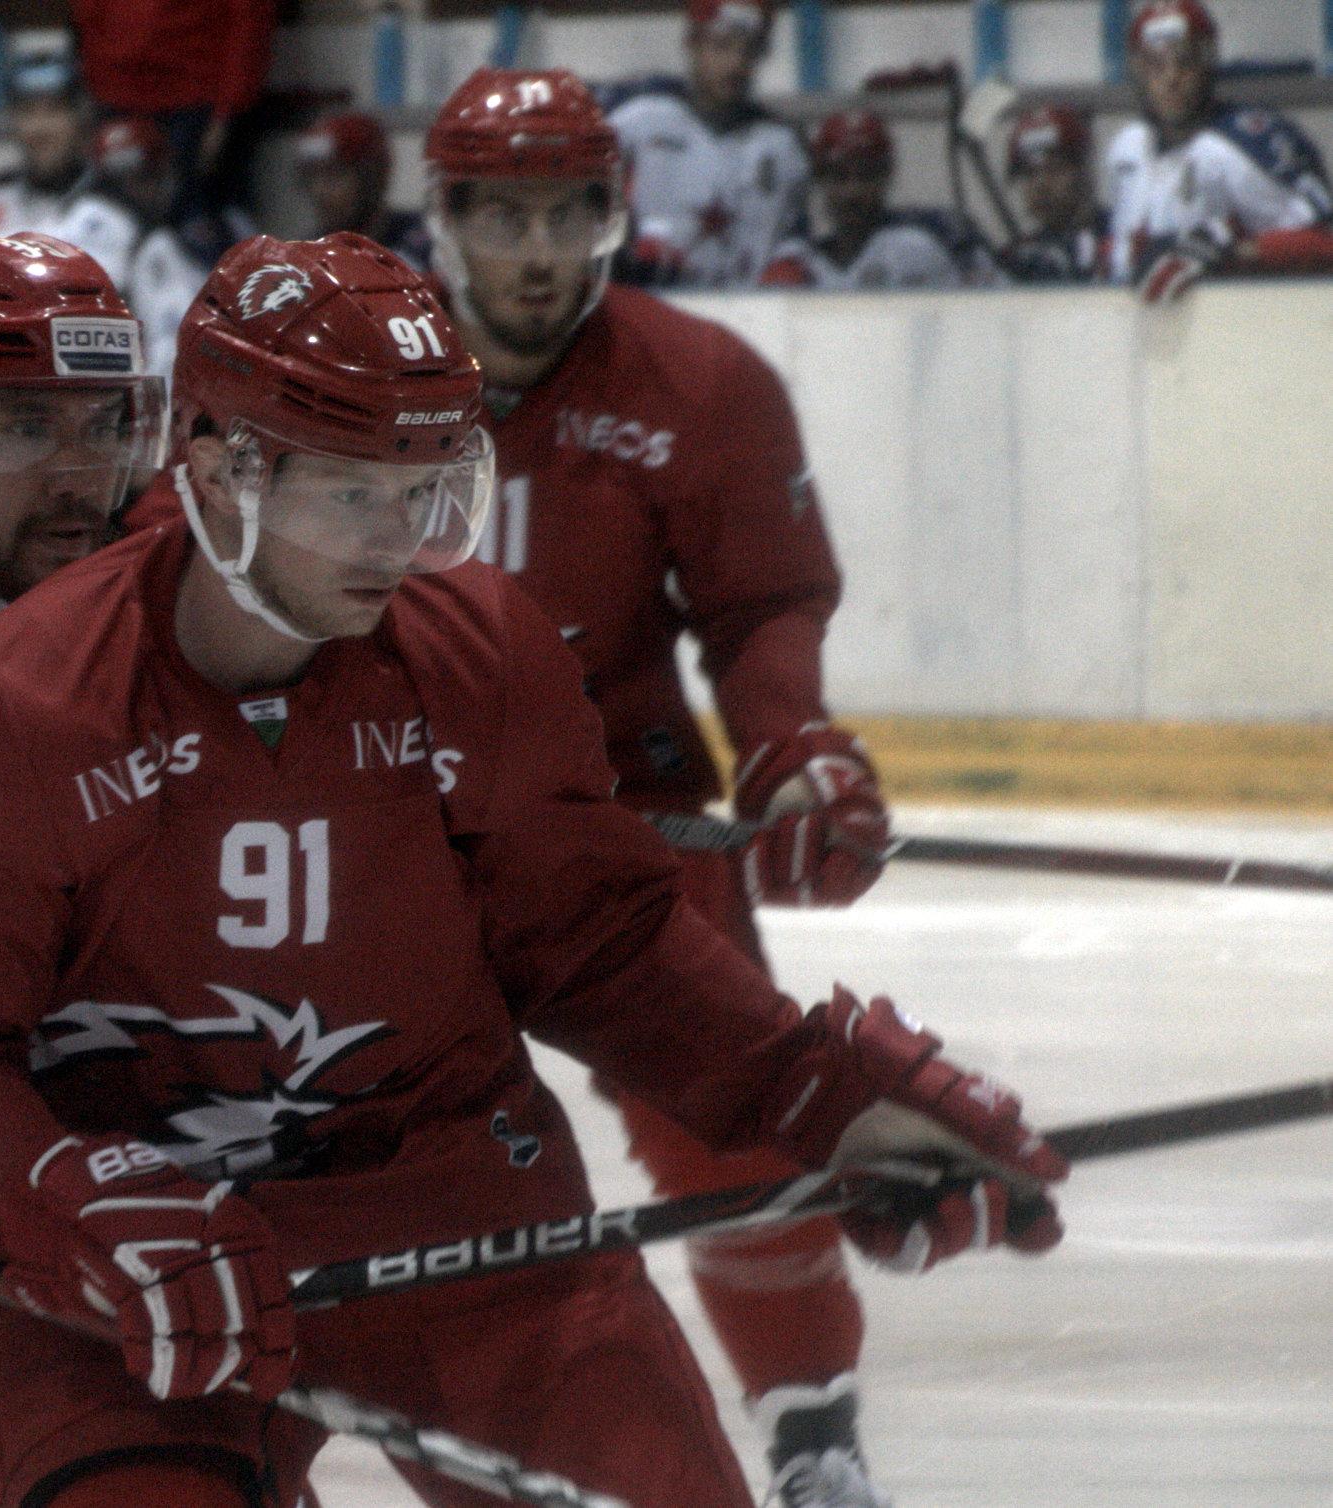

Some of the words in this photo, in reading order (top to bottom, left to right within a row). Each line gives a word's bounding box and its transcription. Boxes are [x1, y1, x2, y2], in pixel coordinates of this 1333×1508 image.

[56, 330, 130, 348] СОГАЗ
[387, 316, 446, 361] 91
[395, 410, 463, 425] BAUER
[217, 820, 329, 949] 91
[368, 1208, 638, 1287] BAUER
